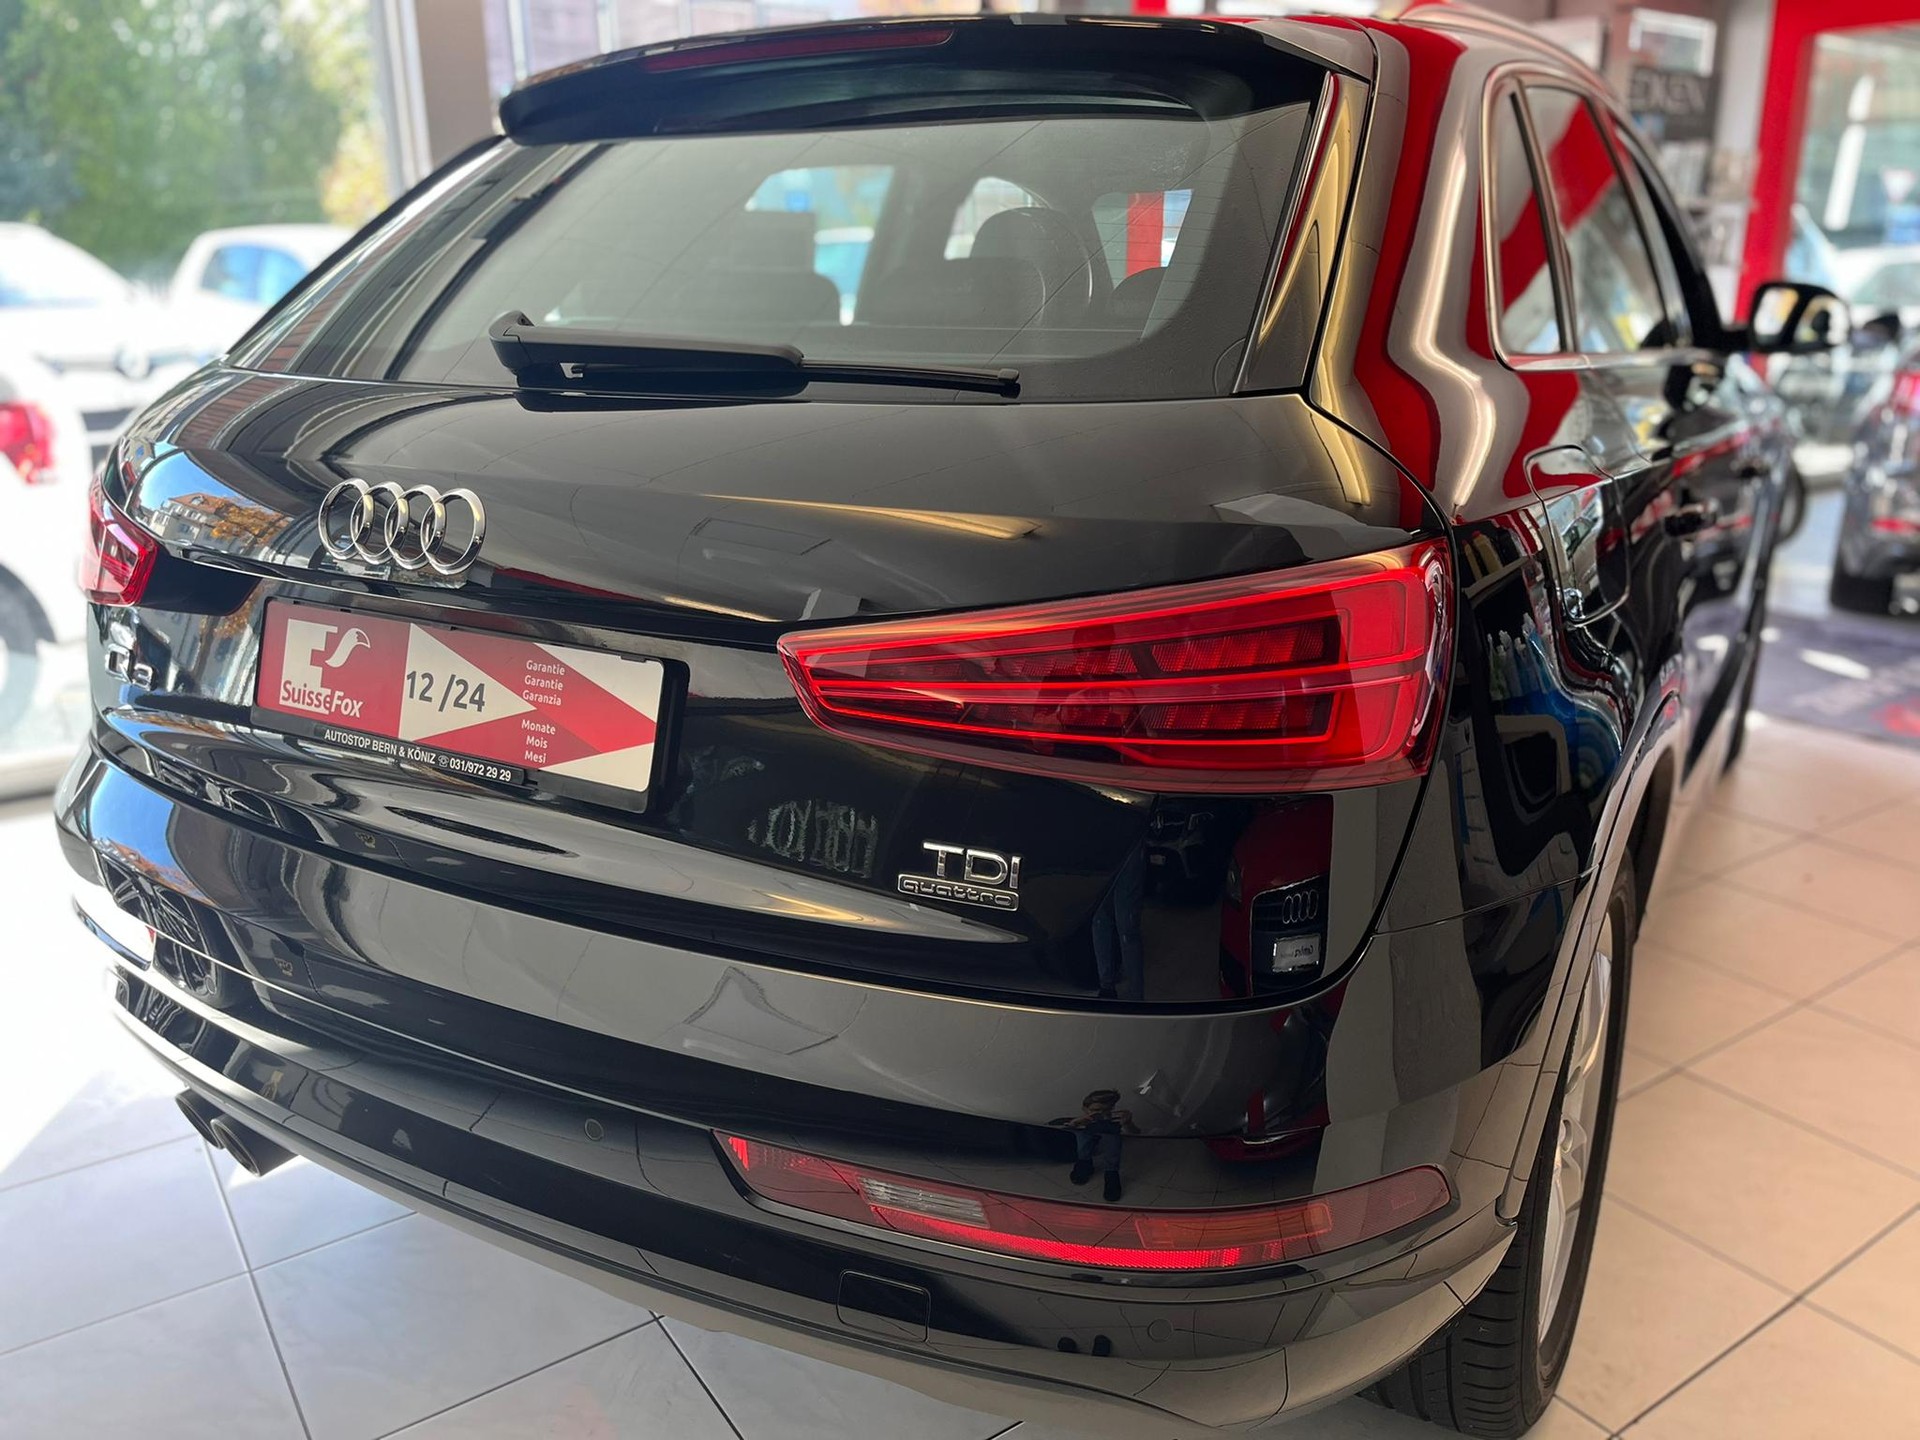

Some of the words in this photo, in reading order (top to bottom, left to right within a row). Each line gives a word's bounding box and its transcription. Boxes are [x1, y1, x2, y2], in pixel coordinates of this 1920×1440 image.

[526, 659, 565, 676] Garantie
[524, 674, 563, 691] Garantie
[281, 680, 363, 718] SuisseFox
[522, 689, 561, 706] Garanzia
[521, 719, 556, 735] Monate
[526, 735, 548, 749] Mois
[324, 729, 371, 749] AUTOSTOP
[372, 739, 397, 756] BERN
[398, 748, 405, 758] &
[407, 747, 436, 764] KÖNIZ
[449, 757, 485, 775] 031/972
[486, 767, 498, 779] 29
[499, 769, 511, 782] 29
[524, 750, 547, 764] Mesi
[923, 842, 1021, 889] TDI
[903, 879, 1012, 906] quattro
